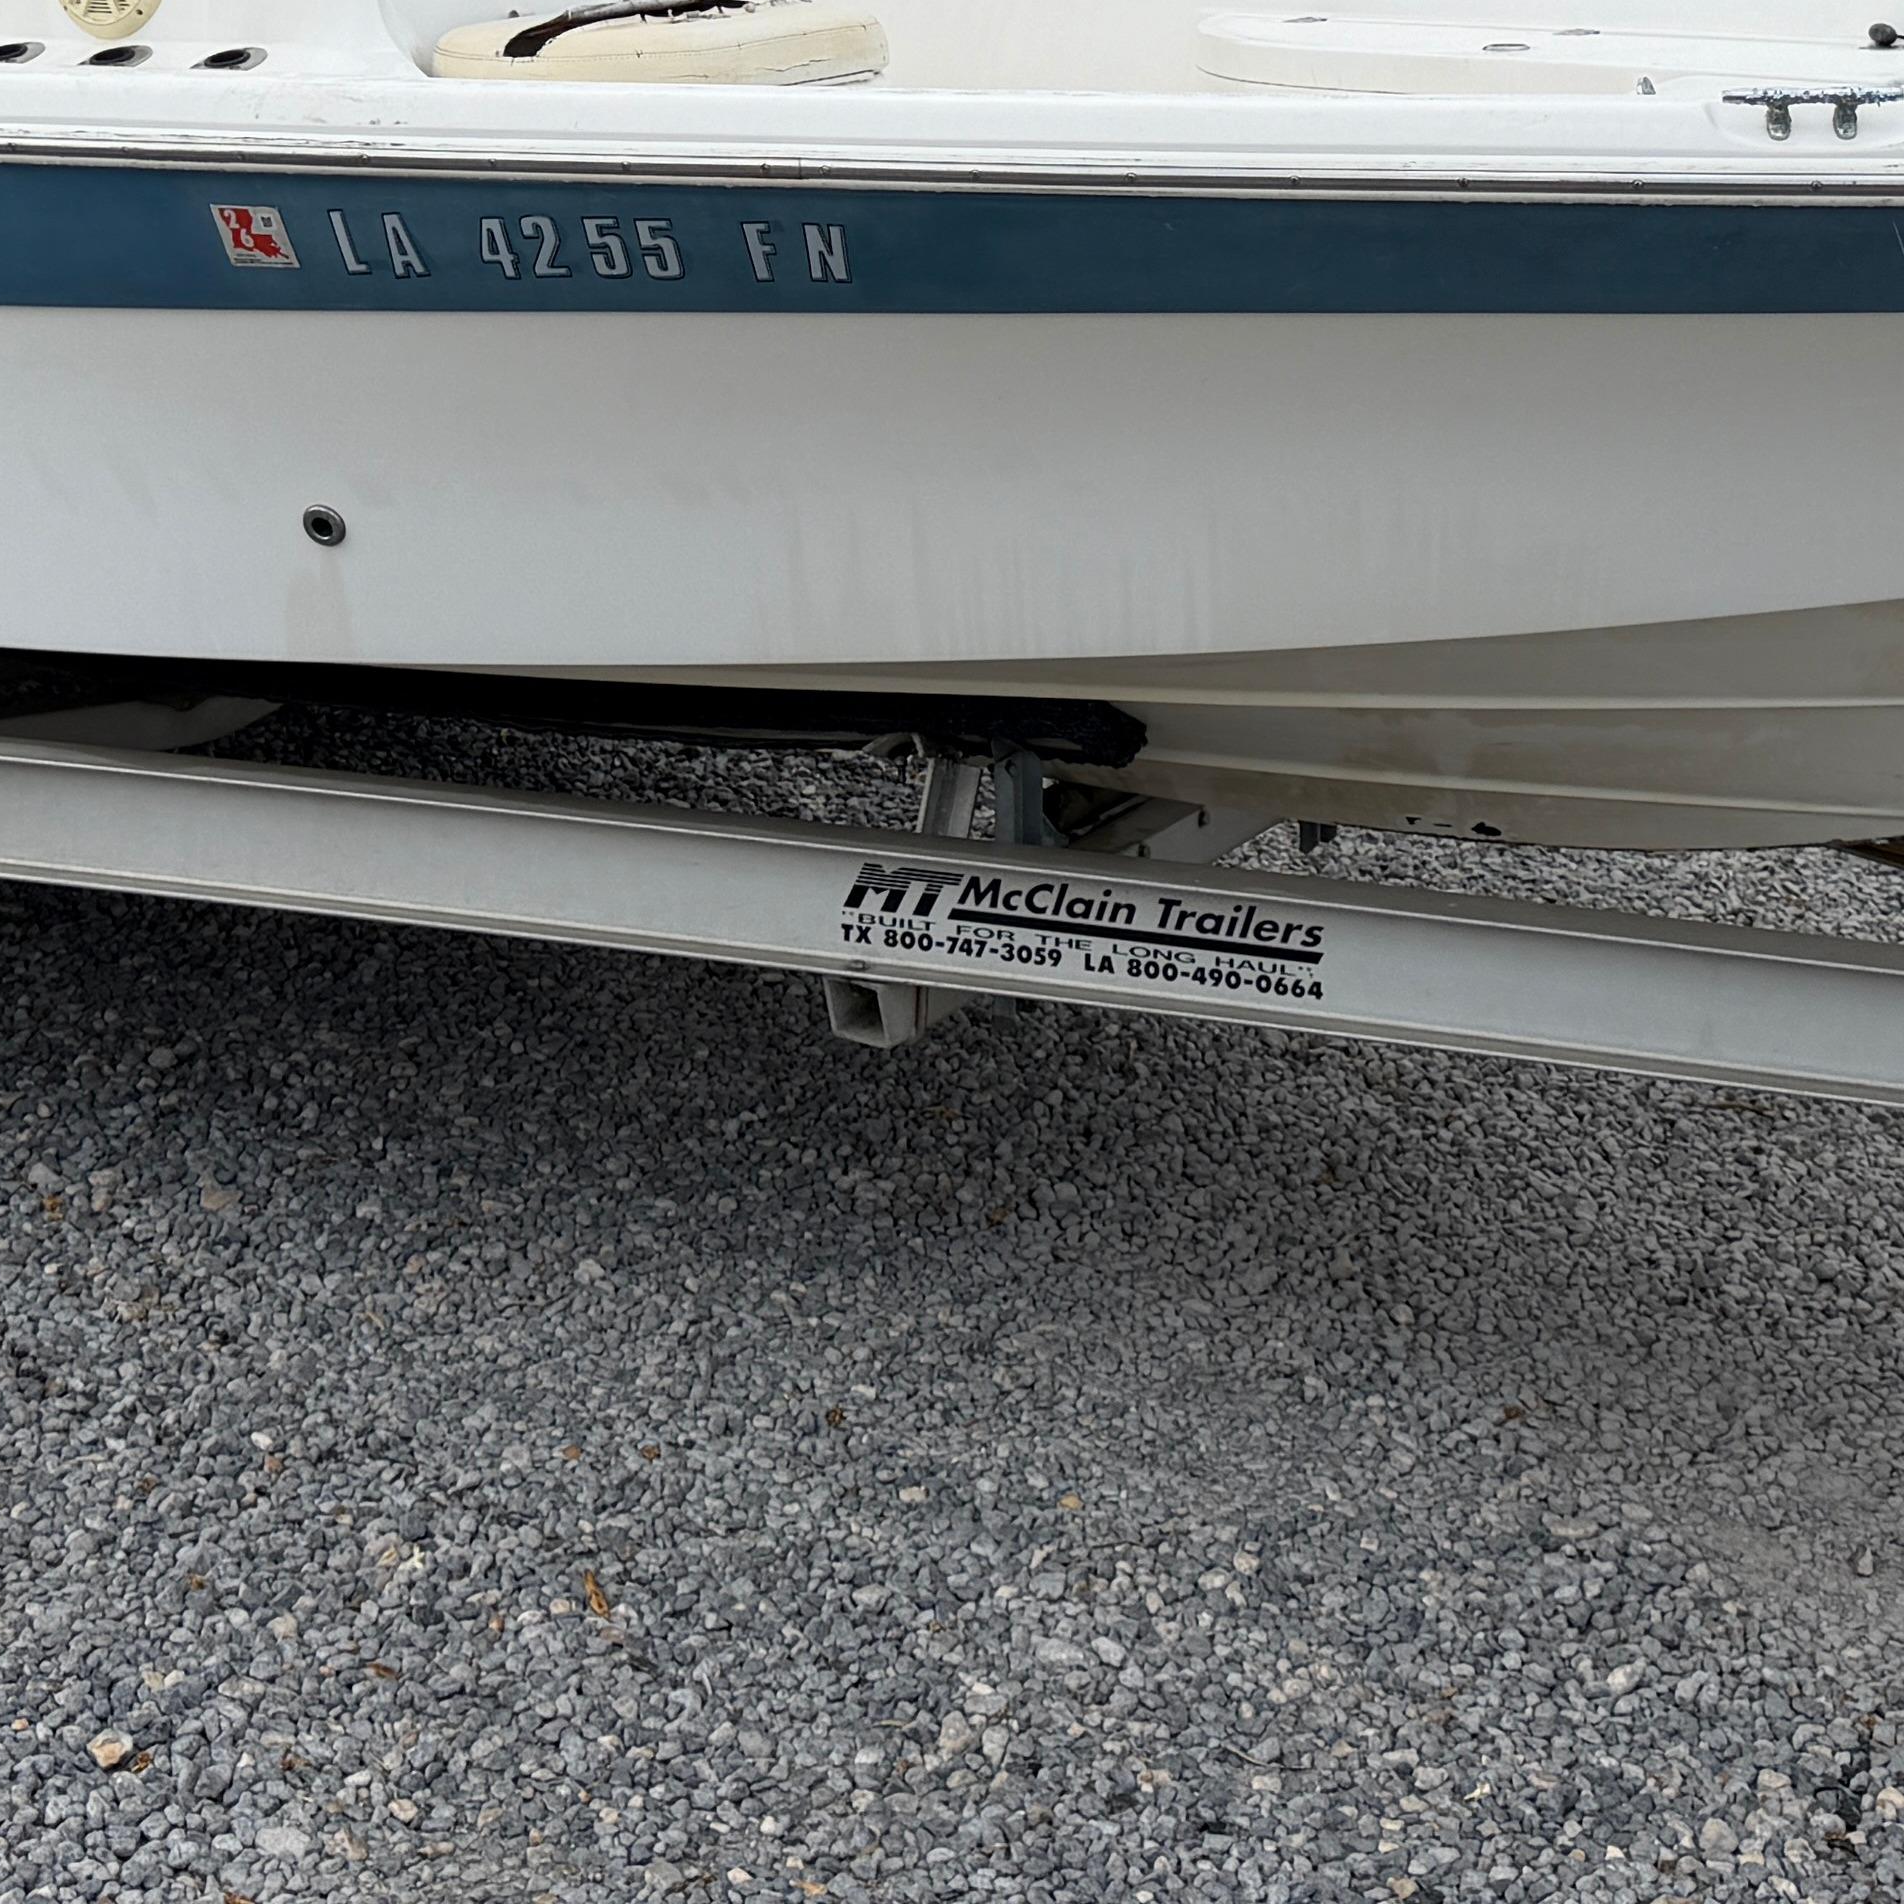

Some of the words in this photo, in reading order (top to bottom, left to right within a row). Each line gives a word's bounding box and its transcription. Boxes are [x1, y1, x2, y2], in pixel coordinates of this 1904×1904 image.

[223, 208, 241, 229] 2
[240, 227, 255, 248] 6
[327, 208, 431, 280] LA
[479, 213, 686, 281] 4255
[739, 219, 853, 284] FN
[843, 861, 965, 917] MT
[957, 875, 1137, 925] McClain
[1158, 897, 1325, 948] Trailers
[840, 923, 872, 945] TX
[883, 929, 1063, 968] 800-747-3059
[1084, 952, 1115, 975] LA
[1127, 958, 1324, 1000] 800-490-0664
[956, 925, 1015, 942] FOR
[1035, 933, 1092, 951] THE
[1112, 943, 1196, 965] LONG
